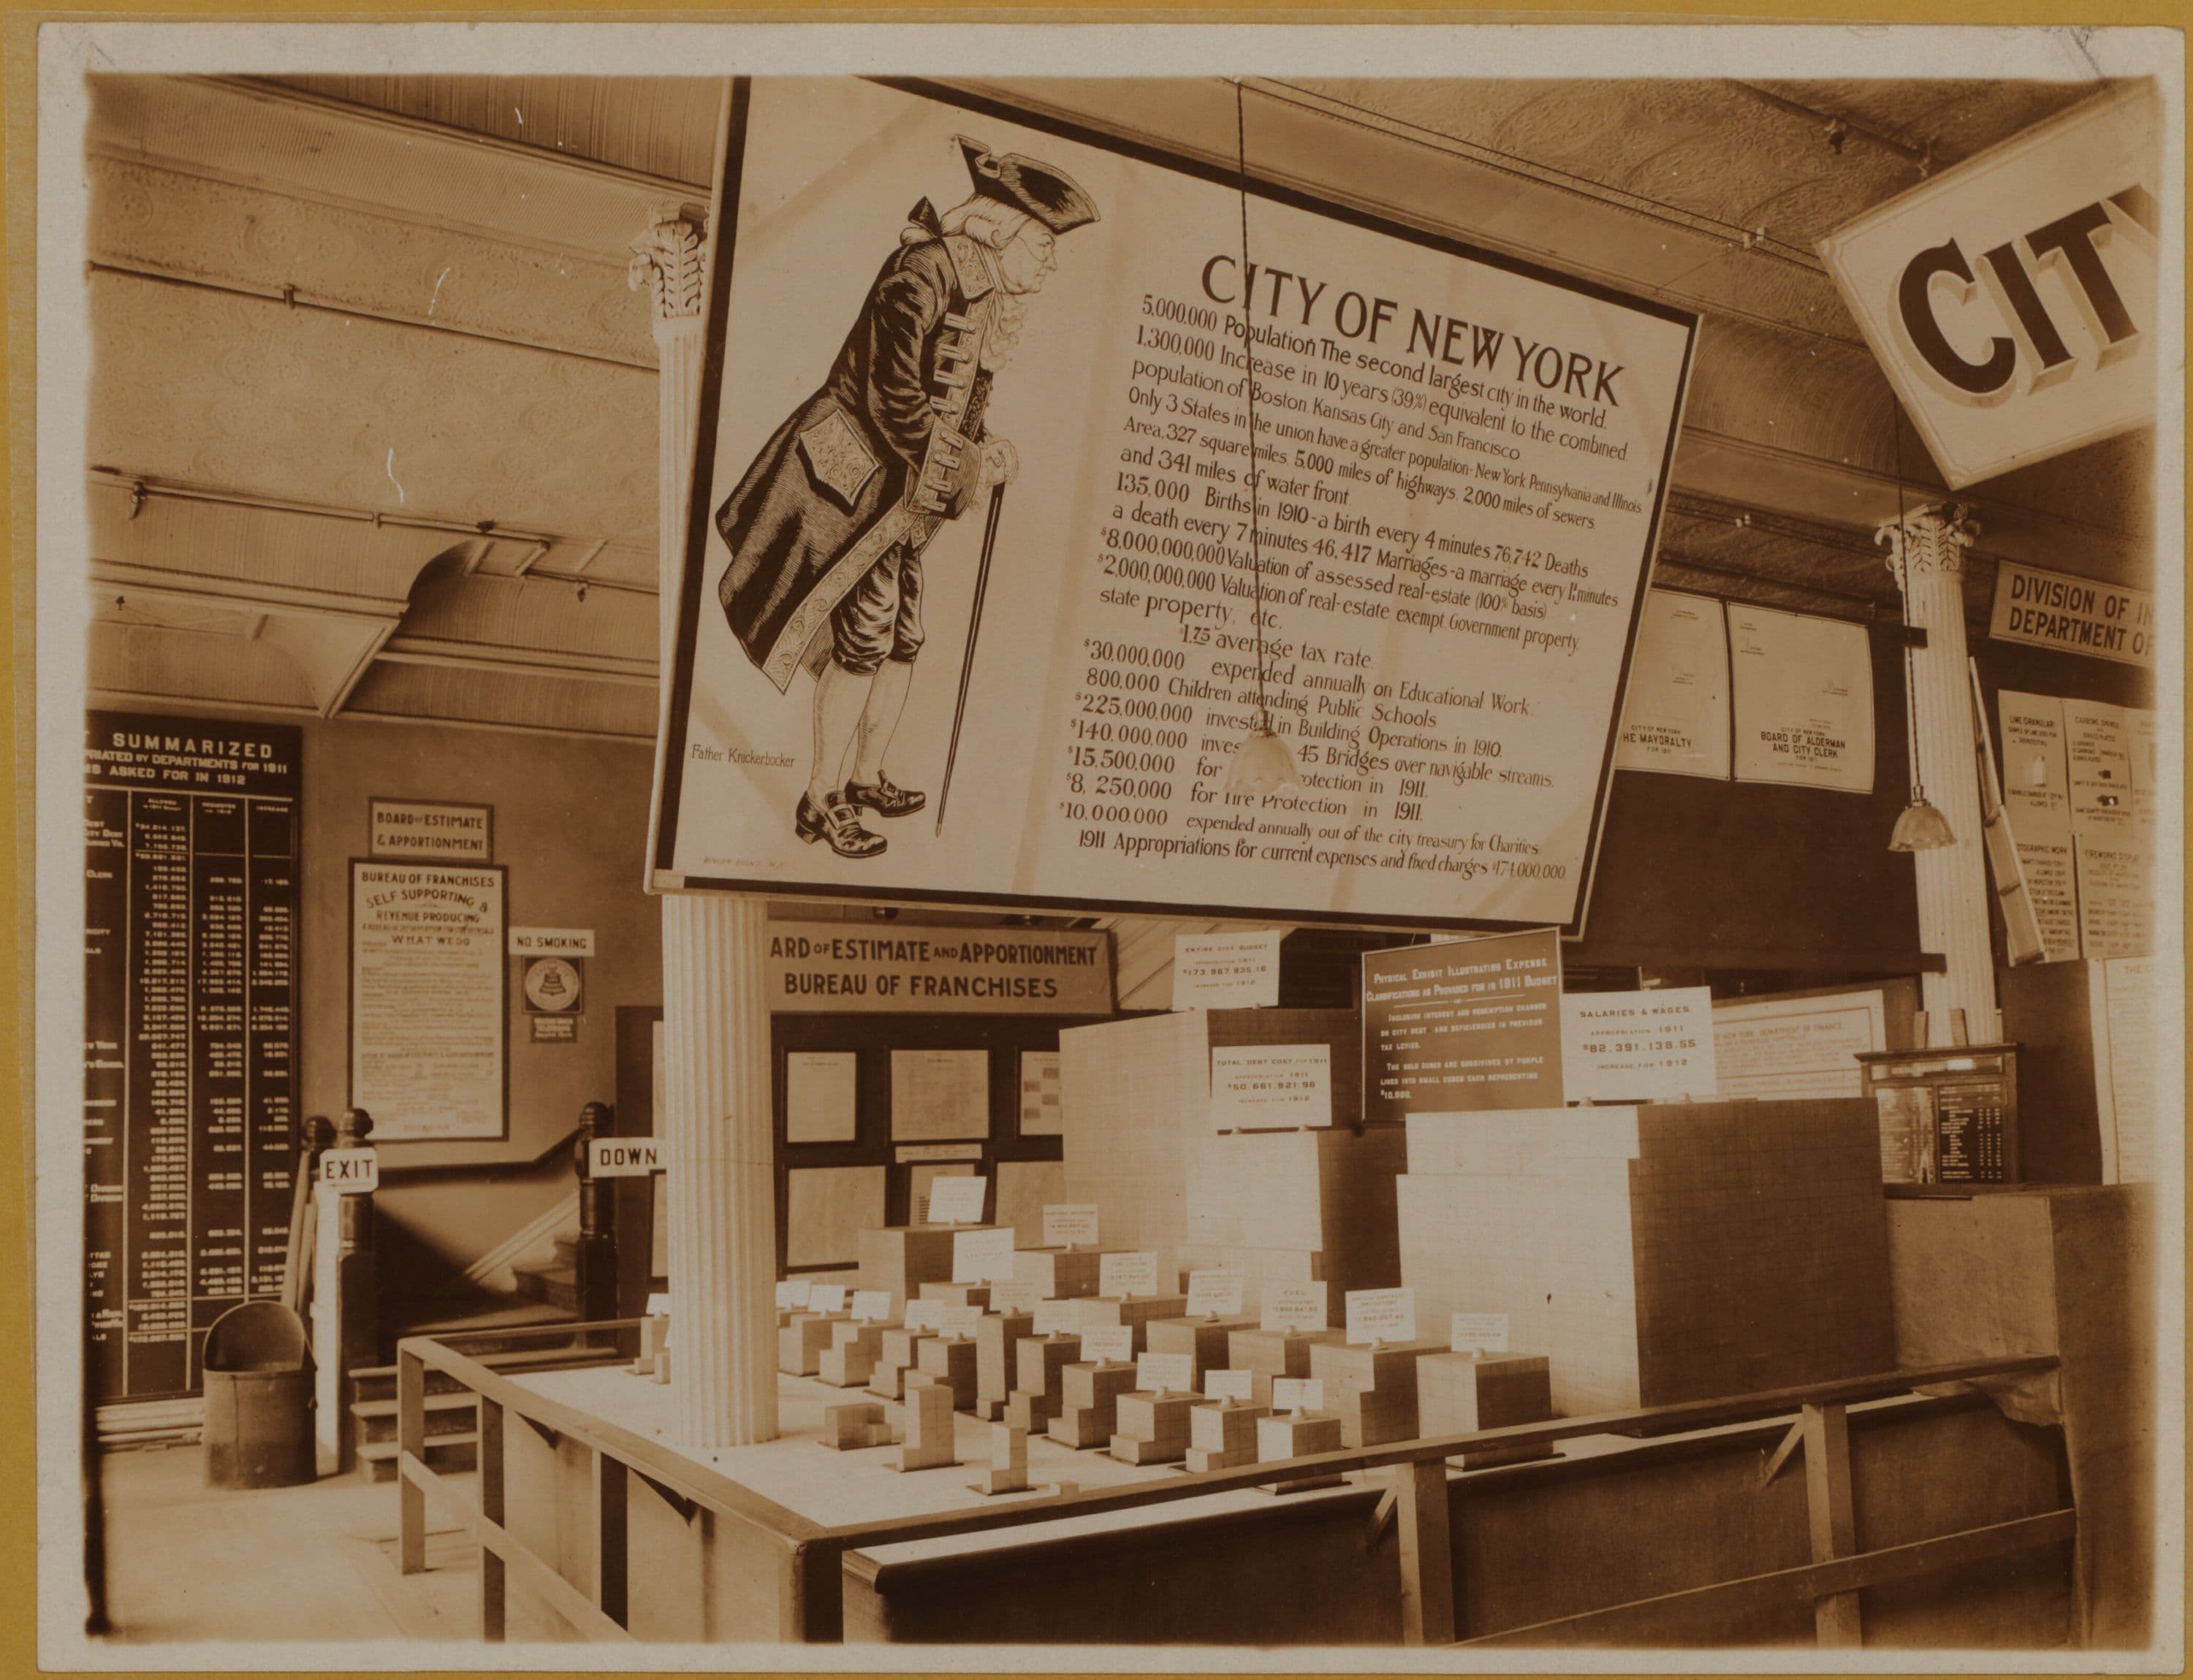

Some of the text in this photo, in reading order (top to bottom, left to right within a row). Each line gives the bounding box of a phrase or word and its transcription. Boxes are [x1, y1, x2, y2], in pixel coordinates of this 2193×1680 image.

[1201, 254, 1626, 408] CITY OF NEW YORK
[1223, 314, 1316, 357] Population
[1320, 338, 1351, 365] The
[1356, 354, 1426, 384] second
[1428, 364, 1486, 400] largest
[1486, 385, 1514, 411] city
[1516, 387, 1529, 410] in
[1532, 393, 1555, 416] the
[1219, 344, 1296, 381] Increase
[1301, 364, 1318, 387] in
[1323, 370, 1340, 392] 10
[1339, 379, 1389, 403] years
[1428, 400, 1506, 432] equivalent
[1511, 416, 1526, 436] to
[1530, 420, 1555, 444] the
[1204, 486, 1255, 514] Births
[1255, 496, 1270, 518] in
[1277, 501, 1310, 524] 1910
[1333, 512, 1370, 537] birth
[1376, 526, 1421, 554] every
[1424, 530, 1436, 550] 4
[1544, 552, 1589, 579] Deaths
[1227, 547, 1290, 577] Valuation
[1294, 560, 1314, 579] of
[1315, 569, 1395, 594] assessed
[1397, 582, 1471, 607] real-estate
[1511, 596, 1547, 620] basis)
[2011, 574, 2096, 615] DIVISION
[2104, 596, 2130, 620] OF
[2010, 607, 2127, 650] DEPARTMENT
[1168, 677, 1231, 702] Children
[1237, 685, 1309, 718] attending
[1318, 695, 1364, 718] Public
[1371, 703, 1437, 728] Schools
[113, 732, 272, 759] SUMMARIZED
[1640, 734, 1692, 748] MAYORALTY
[1761, 731, 1845, 749] BOARD OF ALDERMAN
[692, 745, 796, 767] Father Knickerbocker
[1773, 743, 1838, 759] AND CITY CLERK
[152, 754, 237, 770] DEPARTMENTS
[110, 766, 156, 778] ASKED
[163, 769, 189, 781] FOR
[196, 772, 208, 783] IN
[377, 812, 414, 825] BOARD
[425, 813, 483, 829] ESTIMATE
[389, 835, 483, 851] APPORTIONMENT
[1079, 829, 1489, 881] 1911 Appropriations for current expenses and fixed charges
[362, 871, 495, 888] BUREAU OF FRANCHISES
[366, 891, 396, 909] SELF
[401, 889, 474, 907] SUPPORTING
[423, 912, 480, 924] PRODUCING
[392, 935, 431, 945] WHAT
[517, 937, 587, 949] NO SMOKING
[770, 937, 1097, 965] ARD OF ESTIMATE AND APPORTIONMENT
[784, 973, 1058, 998] BUREAU OF FRANCHISES
[1580, 1006, 1690, 1018] SALARIES & WAGES
[601, 1147, 657, 1166] DOWN
[325, 1159, 373, 1179] EXIT
